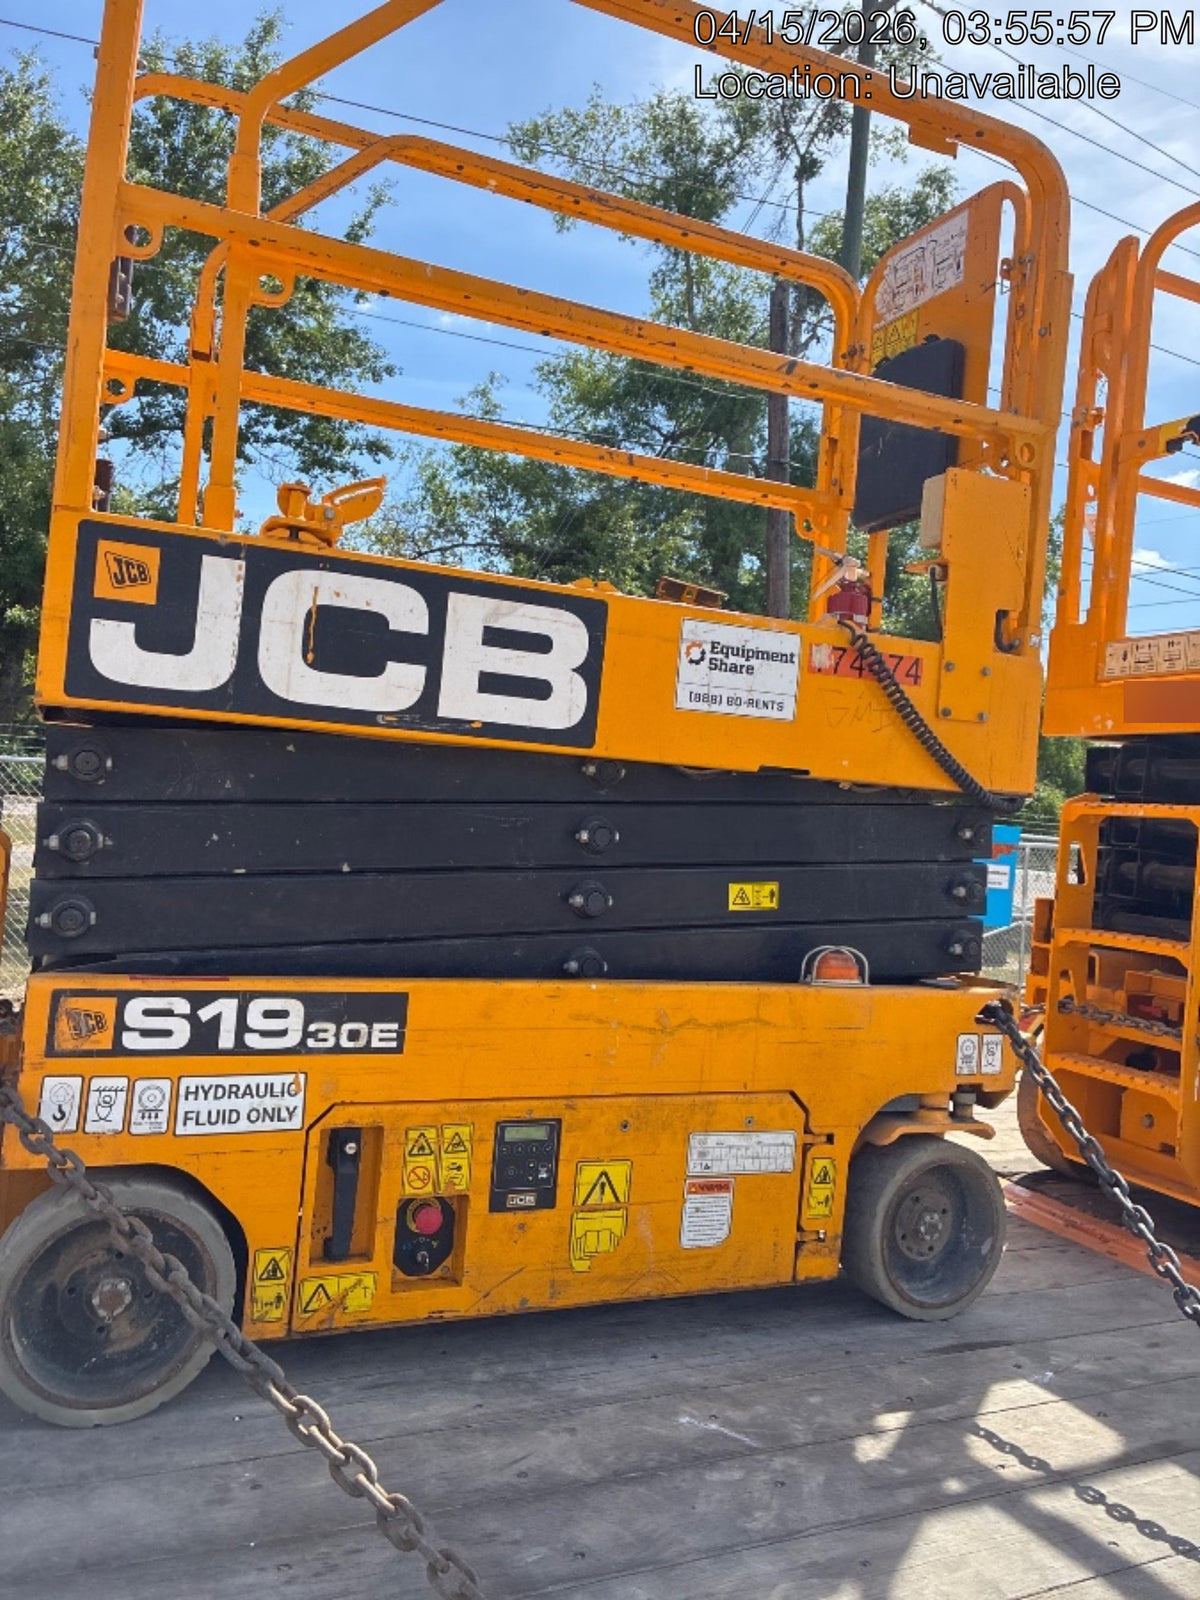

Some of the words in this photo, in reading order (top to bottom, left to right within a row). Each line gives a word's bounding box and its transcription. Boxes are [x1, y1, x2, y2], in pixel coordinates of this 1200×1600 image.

[111, 555, 149, 586] JCB
[89, 554, 589, 730] JCB
[710, 641, 795, 664] Equipment
[708, 658, 755, 675] Share
[184, 1082, 301, 1101] HYDRAULIC
[183, 1108, 241, 1127] FLUID
[247, 1105, 298, 1124] ONLY
